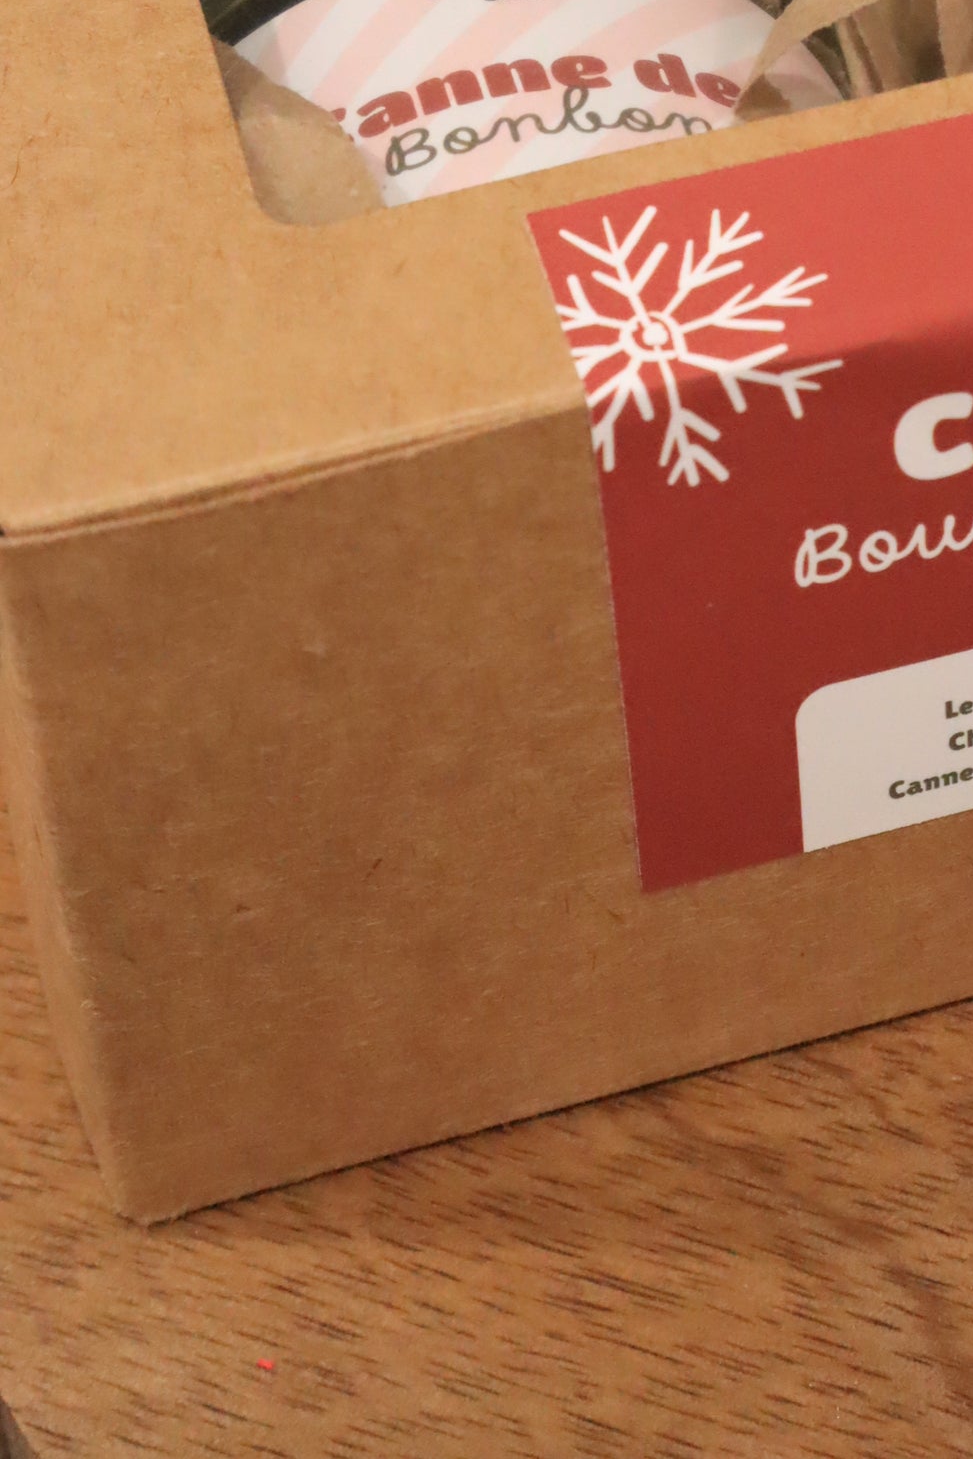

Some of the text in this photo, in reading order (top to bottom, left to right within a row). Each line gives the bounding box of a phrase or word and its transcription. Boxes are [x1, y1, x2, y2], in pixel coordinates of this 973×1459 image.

[331, 53, 741, 142] anne de
[944, 697, 973, 720] Le
